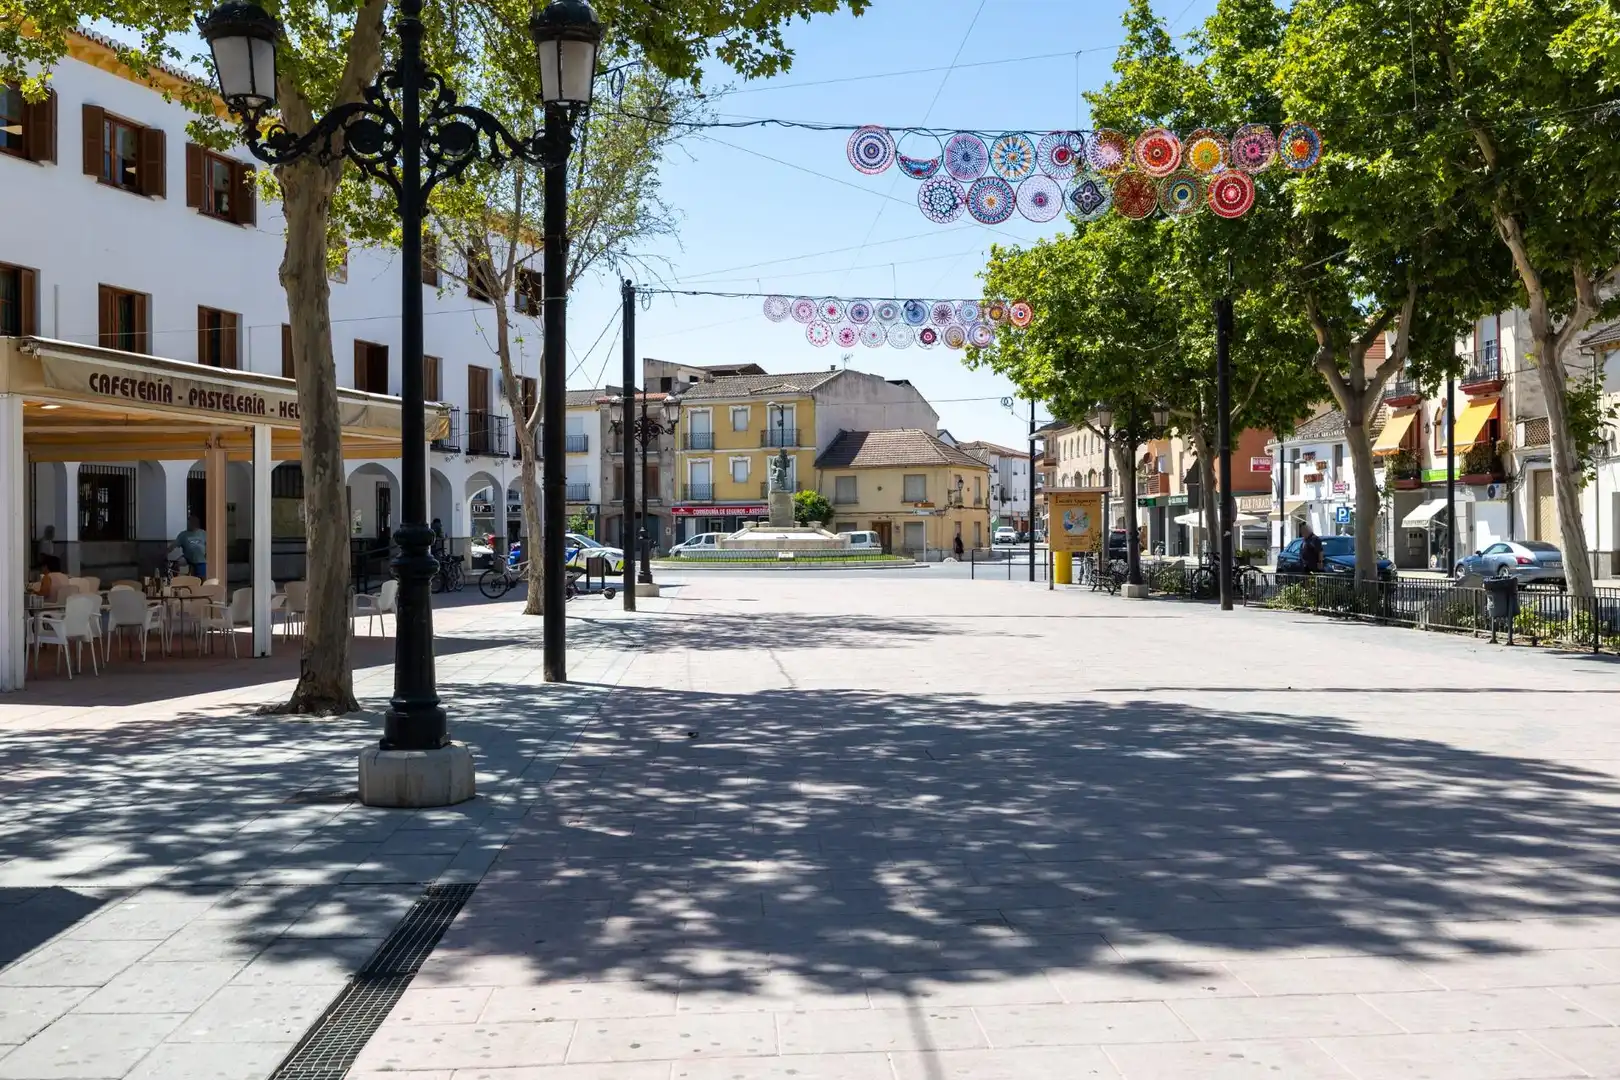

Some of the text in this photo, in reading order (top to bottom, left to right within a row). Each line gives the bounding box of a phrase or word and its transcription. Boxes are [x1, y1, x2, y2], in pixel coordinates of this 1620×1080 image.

[89, 373, 172, 403] CAFETERÍA
[189, 388, 265, 415] PASTELERÍA
[279, 401, 300, 419] HEL
[1339, 508, 1347, 521] P
